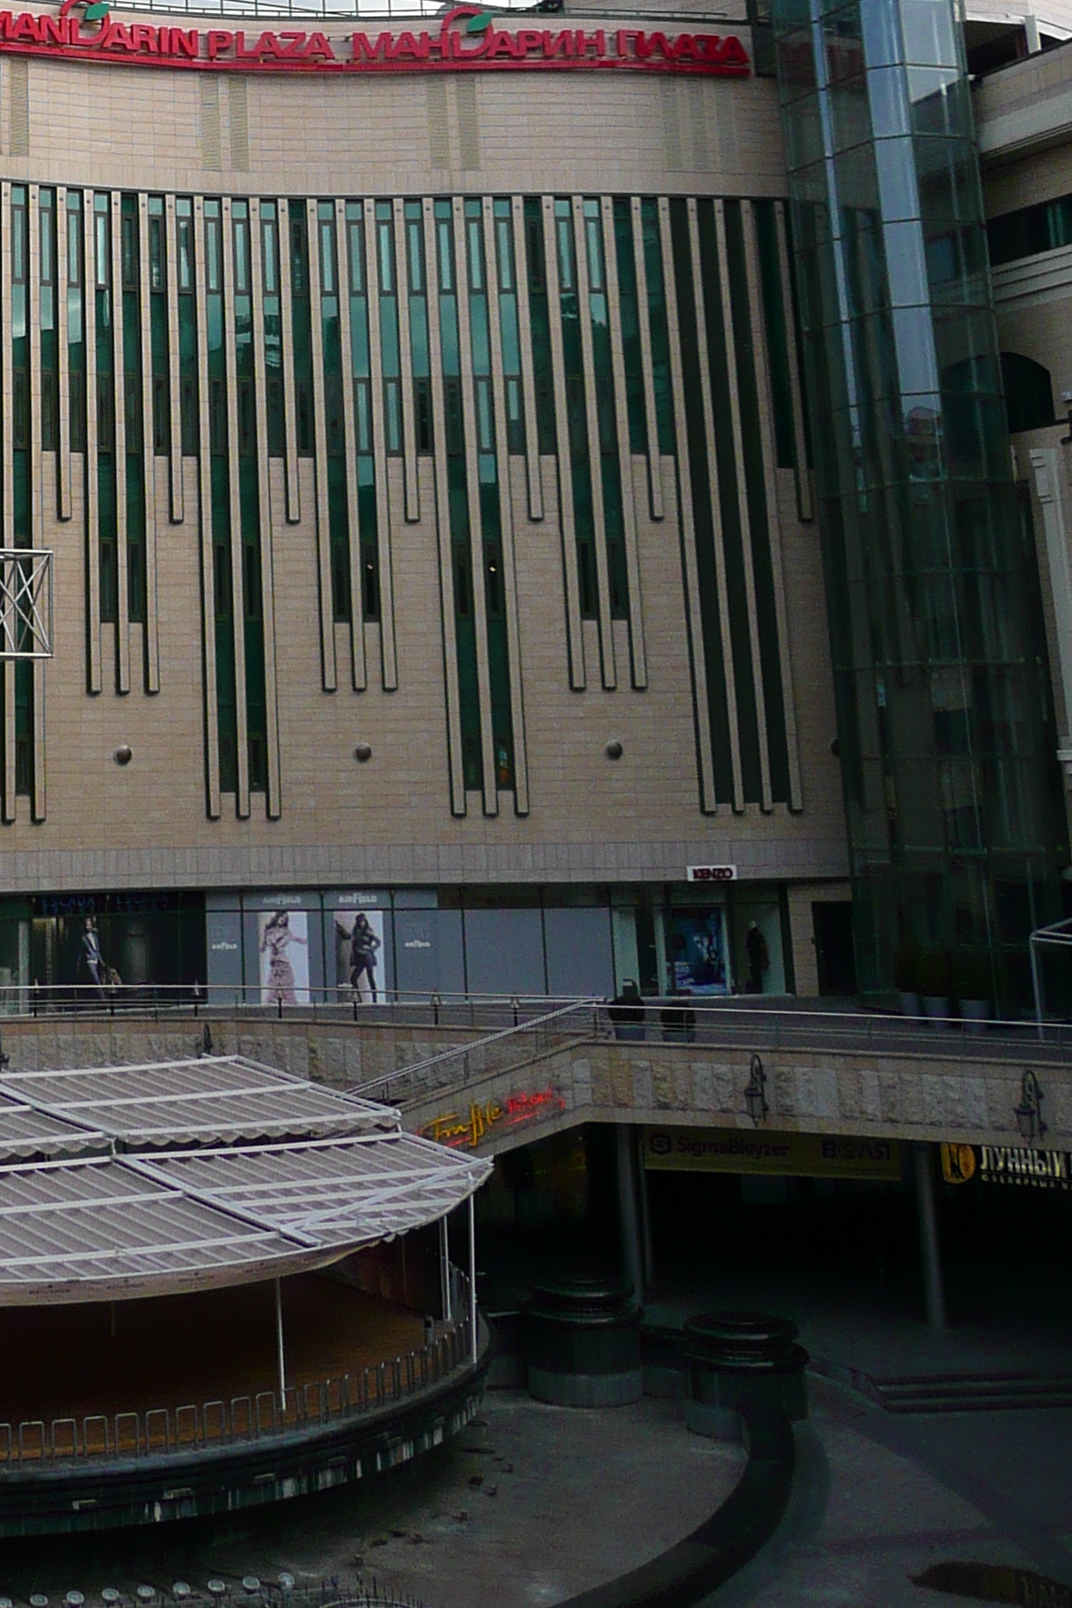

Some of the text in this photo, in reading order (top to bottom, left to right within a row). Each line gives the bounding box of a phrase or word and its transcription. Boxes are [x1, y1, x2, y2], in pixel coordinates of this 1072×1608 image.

[208, 29, 335, 60] PLAZA
[692, 867, 733, 880] KENZO
[419, 1099, 504, 1148] Truffle
